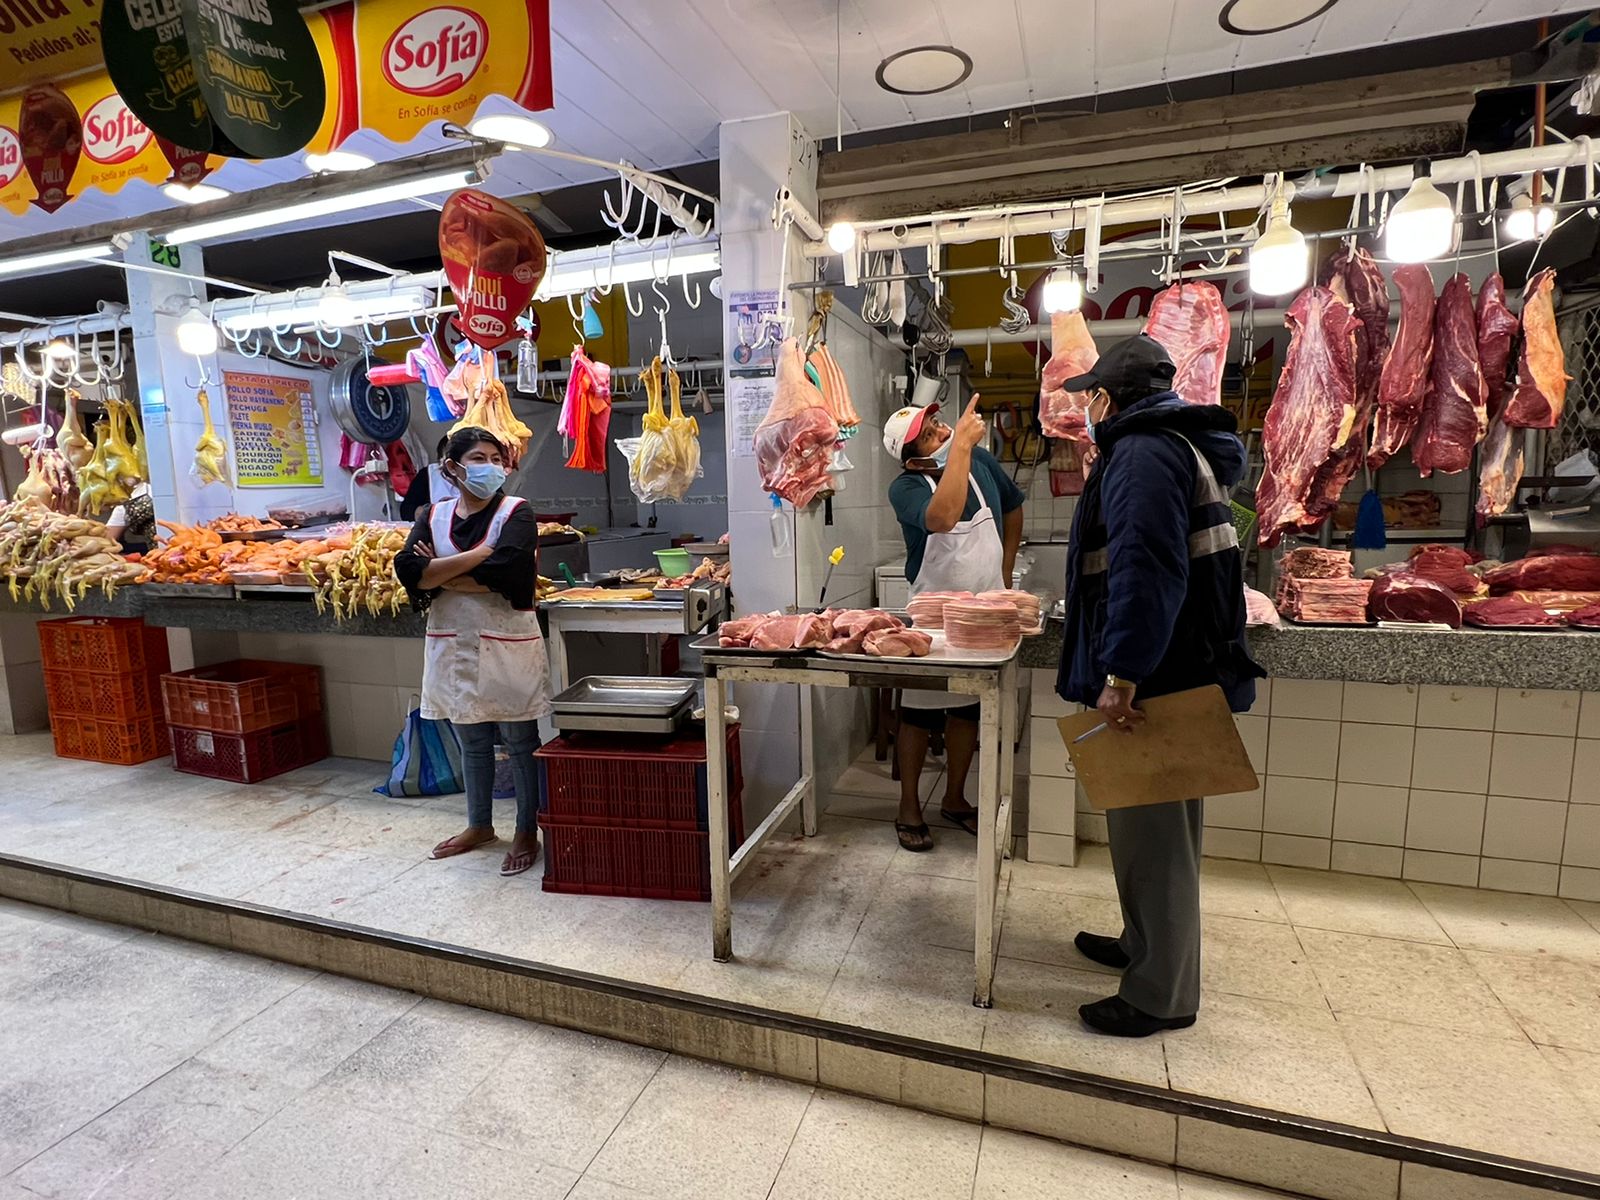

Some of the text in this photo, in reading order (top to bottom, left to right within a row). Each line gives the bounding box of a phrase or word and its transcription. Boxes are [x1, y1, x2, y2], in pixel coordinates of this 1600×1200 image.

[9, 36, 74, 65] Pedidos
[72, 25, 97, 47] al:
[394, 21, 477, 77] Sofía
[398, 107, 410, 119] En
[414, 104, 439, 118] Sofía
[442, 104, 451, 114] se
[472, 276, 503, 296] AQUÍ
[466, 289, 507, 311] POLLO
[470, 316, 504, 333] Sofía
[227, 385, 251, 394] POLLO
[228, 394, 248, 402] POLLO
[230, 404, 267, 413] PECHUGA
